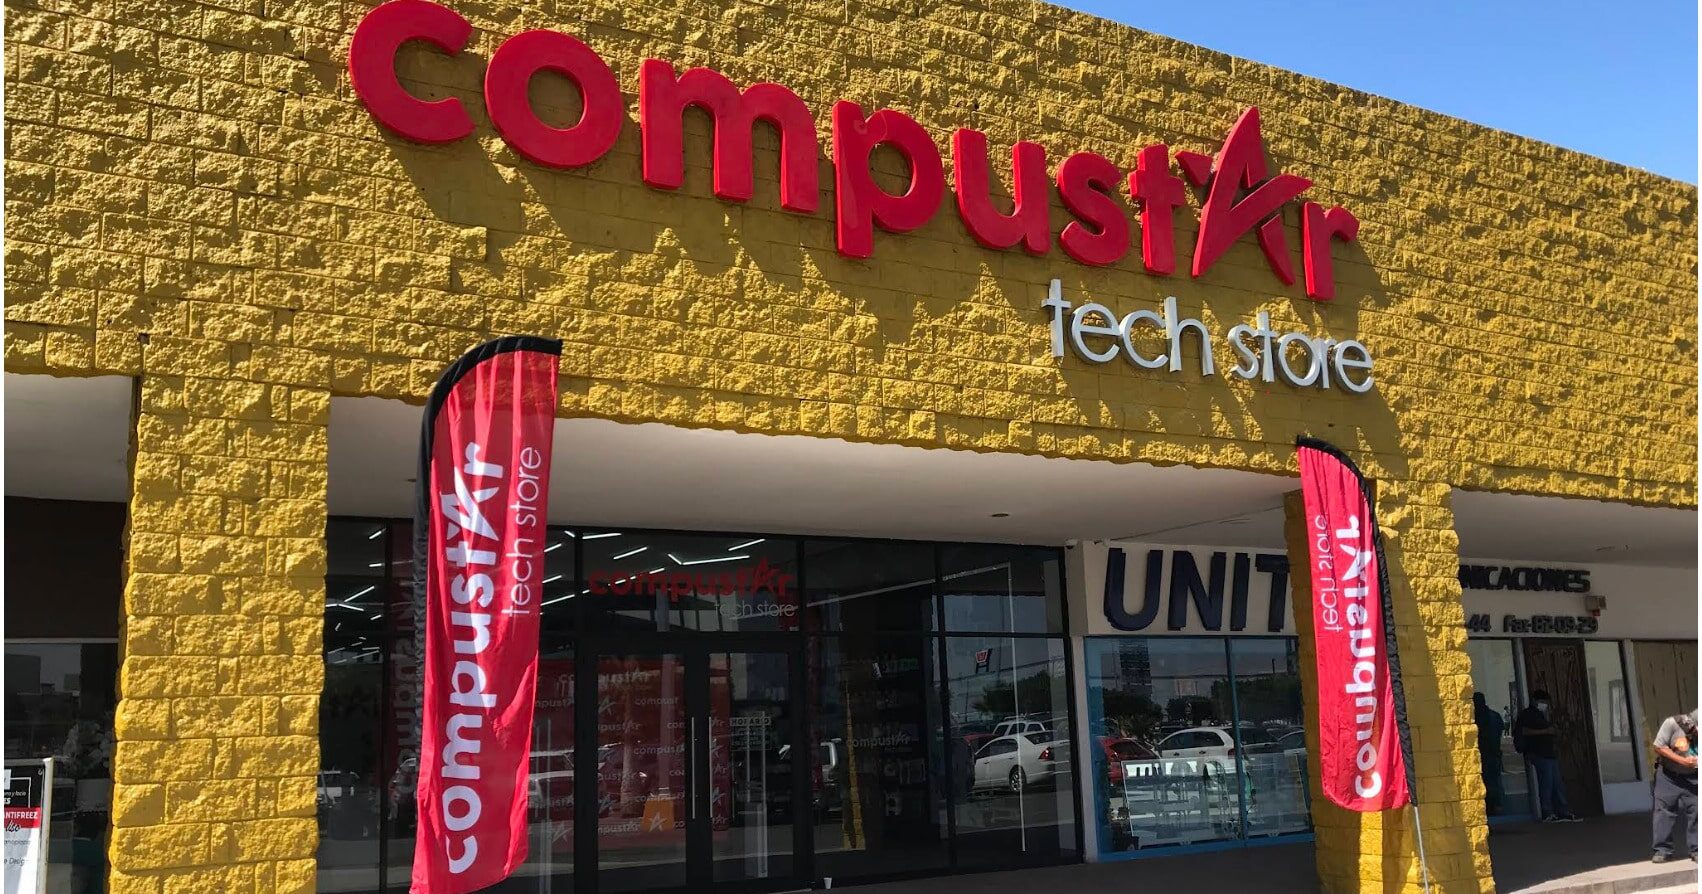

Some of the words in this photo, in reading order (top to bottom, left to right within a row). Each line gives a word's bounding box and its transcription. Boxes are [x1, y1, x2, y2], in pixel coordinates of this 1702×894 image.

[1041, 278, 1215, 376] tech
[1227, 311, 1375, 393] store
[515, 447, 542, 527] store
[501, 535, 535, 618] tech
[714, 601, 751, 617] tech
[757, 600, 795, 617] store
